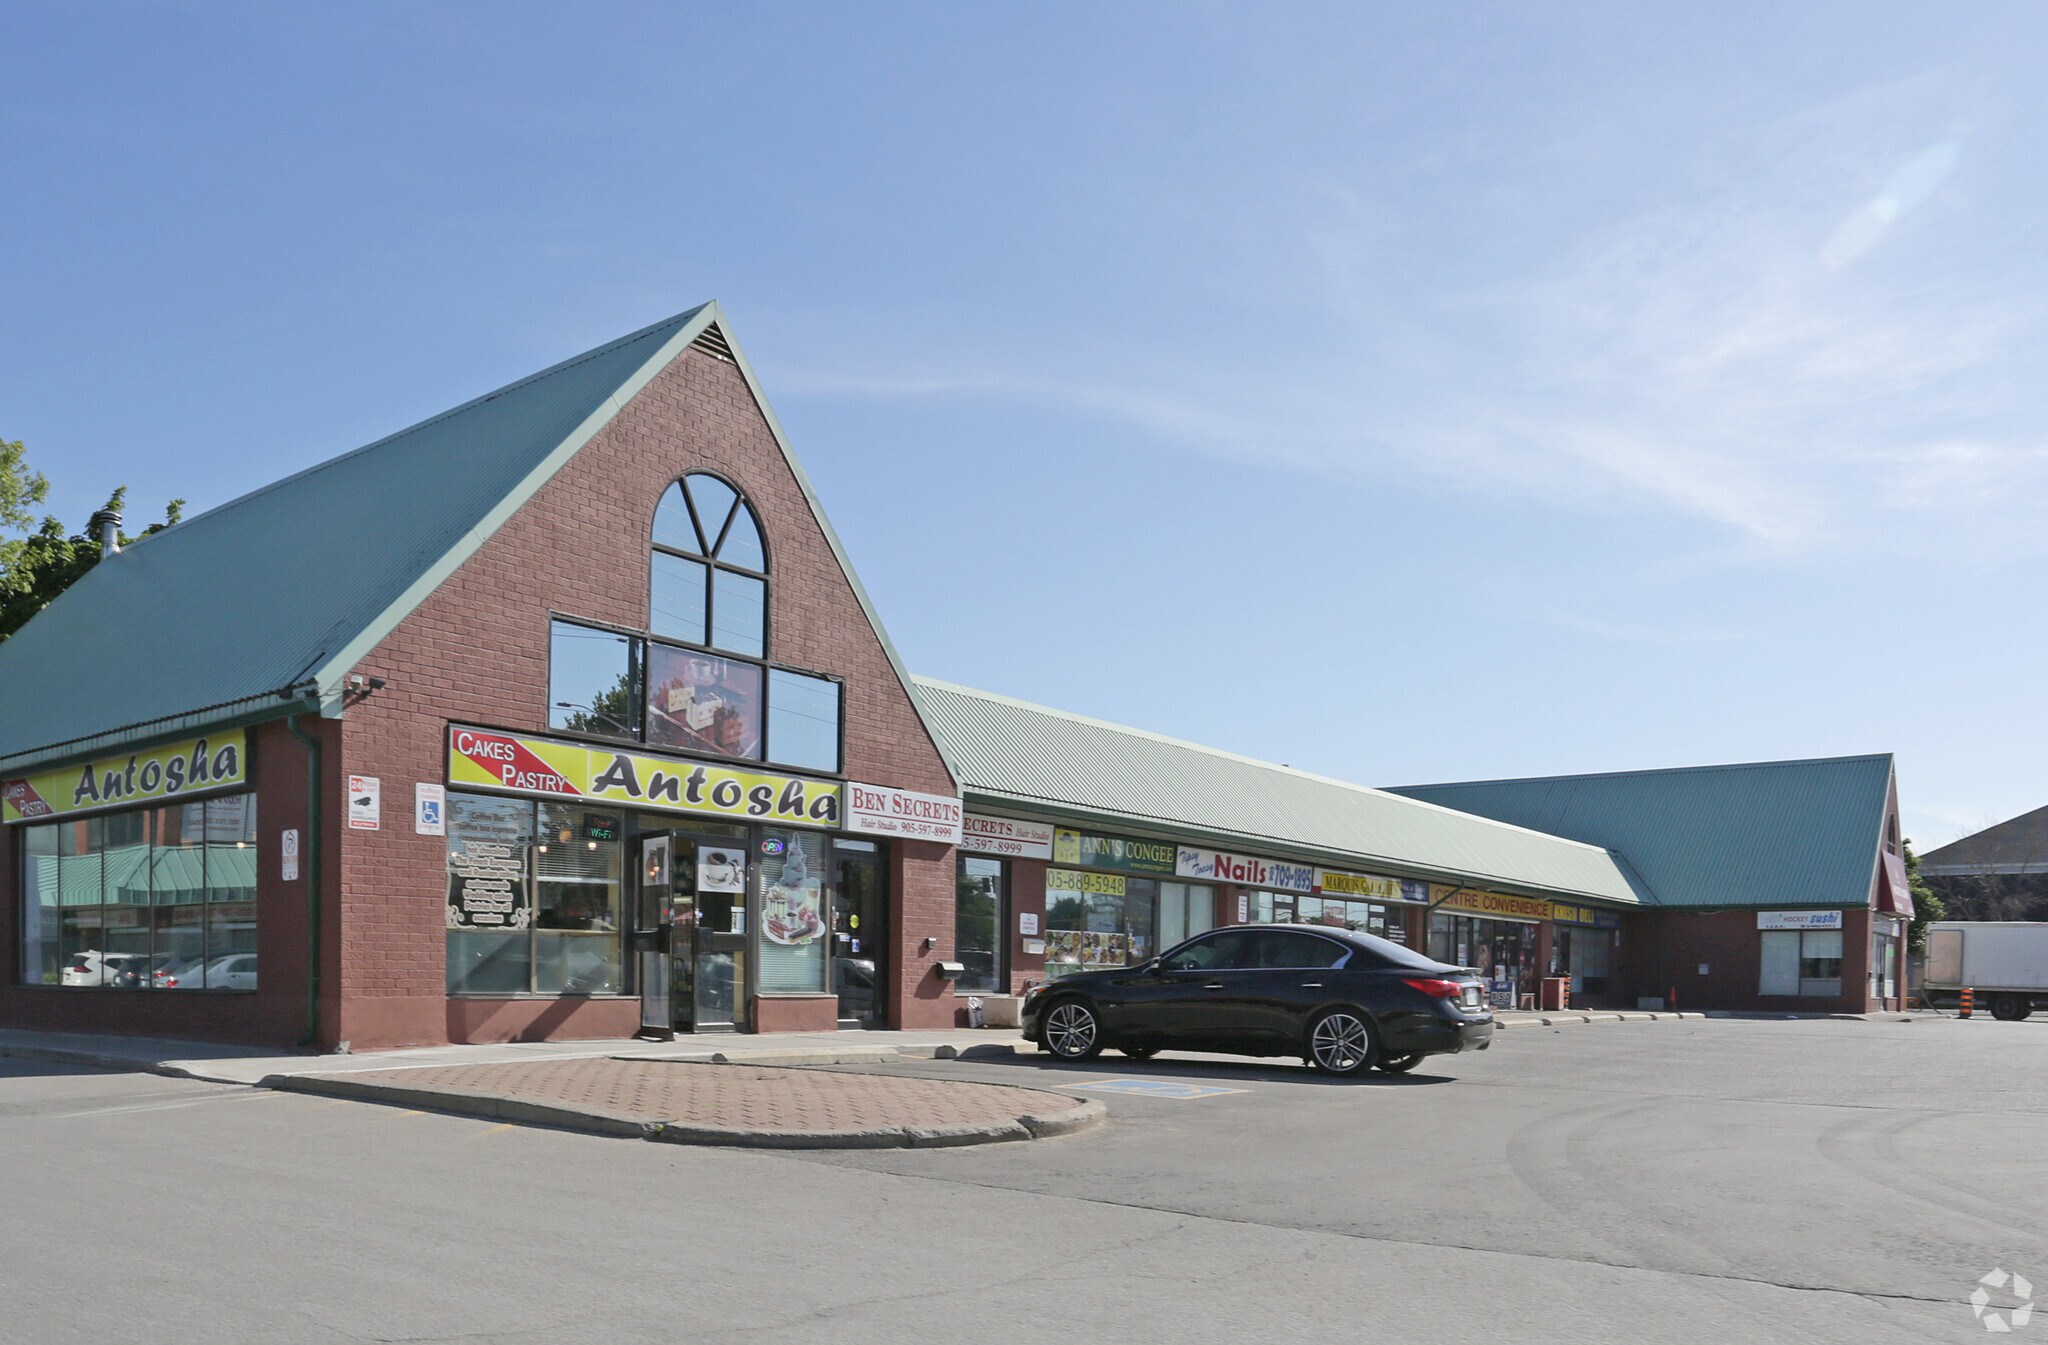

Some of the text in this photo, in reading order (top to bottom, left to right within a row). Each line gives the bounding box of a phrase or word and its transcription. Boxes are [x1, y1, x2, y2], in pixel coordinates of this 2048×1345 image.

[458, 732, 515, 762] CAKES
[72, 737, 239, 806] Antosha
[502, 763, 567, 792] PASTRY
[591, 754, 840, 822] Antosha
[19, 798, 46, 817] PASTRY
[852, 787, 960, 823] BEN SECRETS
[590, 827, 612, 839] Wi-Fi
[860, 818, 952, 838] Hair Studio 905-597-8999
[963, 817, 1050, 841] ECRETS Hair Studio
[761, 841, 784, 852] OPEN
[958, 837, 1022, 854] 5-597-8999
[1082, 837, 1174, 863] ANN'S CONGEE
[1214, 854, 1267, 884] Nails
[1274, 864, 1312, 890] 709-1895
[491, 880, 510, 889] made
[1047, 870, 1124, 894] 05-889-5948
[1435, 888, 1478, 908] CENTRE
[1483, 895, 1548, 916] CONVENIENCE
[1783, 912, 1840, 924] HOCKEY sushi
